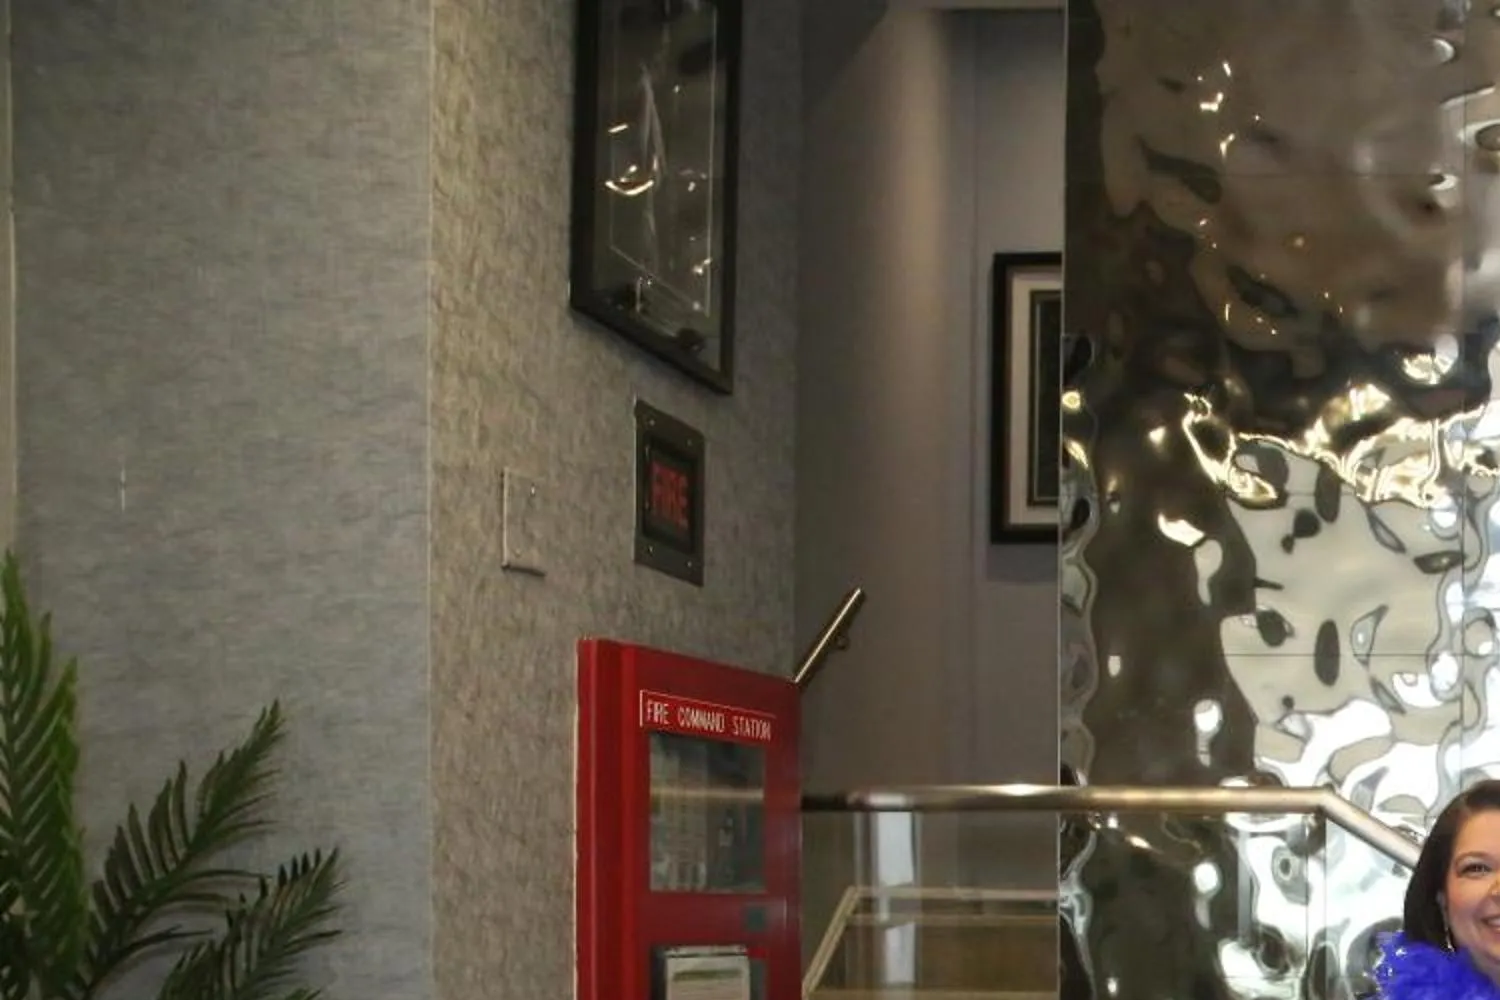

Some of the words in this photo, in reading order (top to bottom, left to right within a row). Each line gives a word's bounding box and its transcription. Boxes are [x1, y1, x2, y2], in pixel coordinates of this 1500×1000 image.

[652, 462, 688, 529] FIRE
[646, 699, 669, 724] FIRE
[678, 706, 725, 733] COMMAND
[732, 715, 771, 740] STATION
